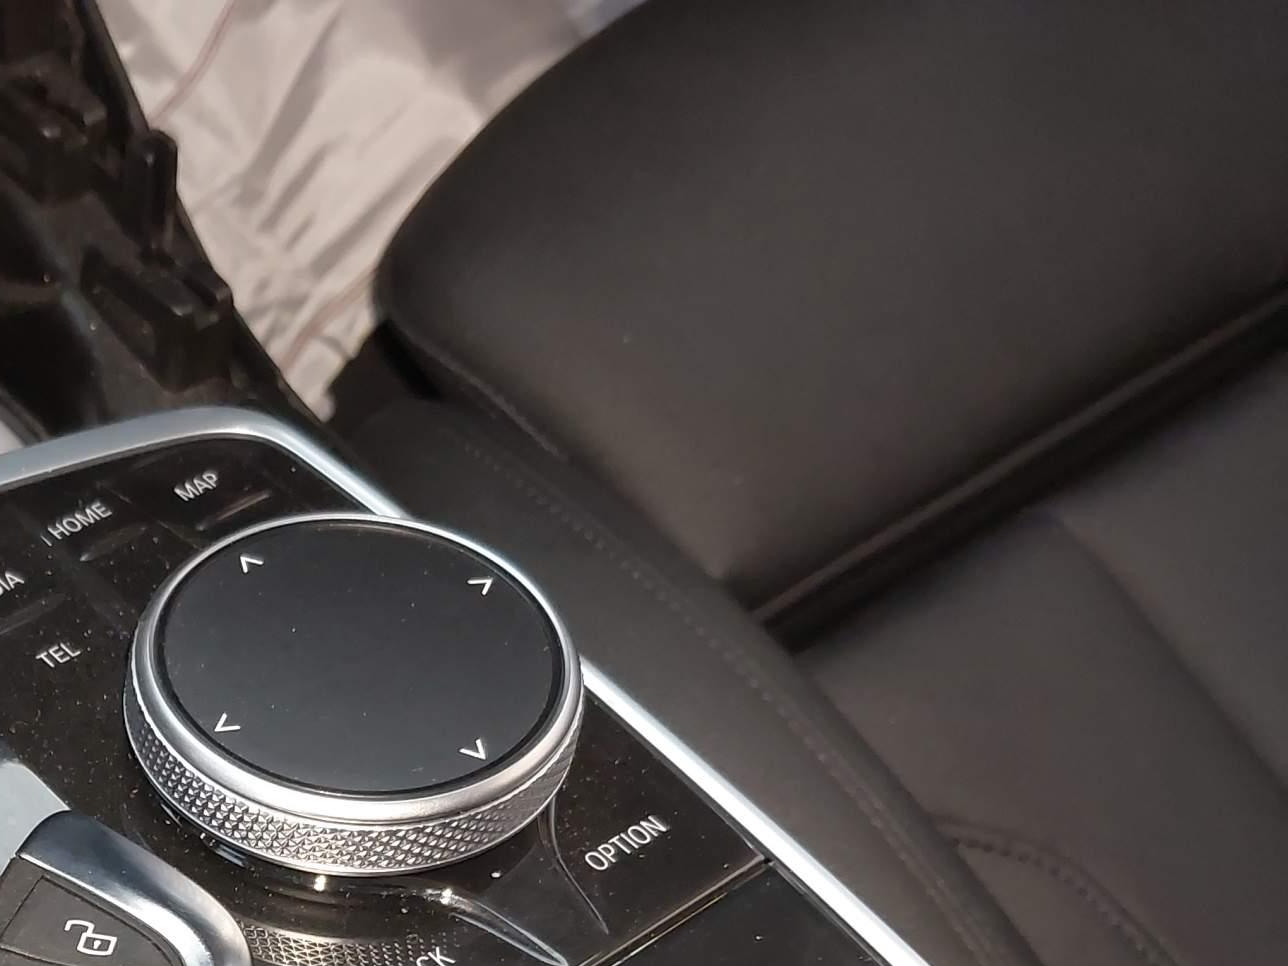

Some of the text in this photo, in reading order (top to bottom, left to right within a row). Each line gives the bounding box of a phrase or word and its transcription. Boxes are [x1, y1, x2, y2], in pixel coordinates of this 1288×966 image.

[174, 470, 220, 503] MAP
[48, 502, 112, 543] HOME
[36, 642, 81, 670] TEL
[585, 815, 668, 872] OPTION
